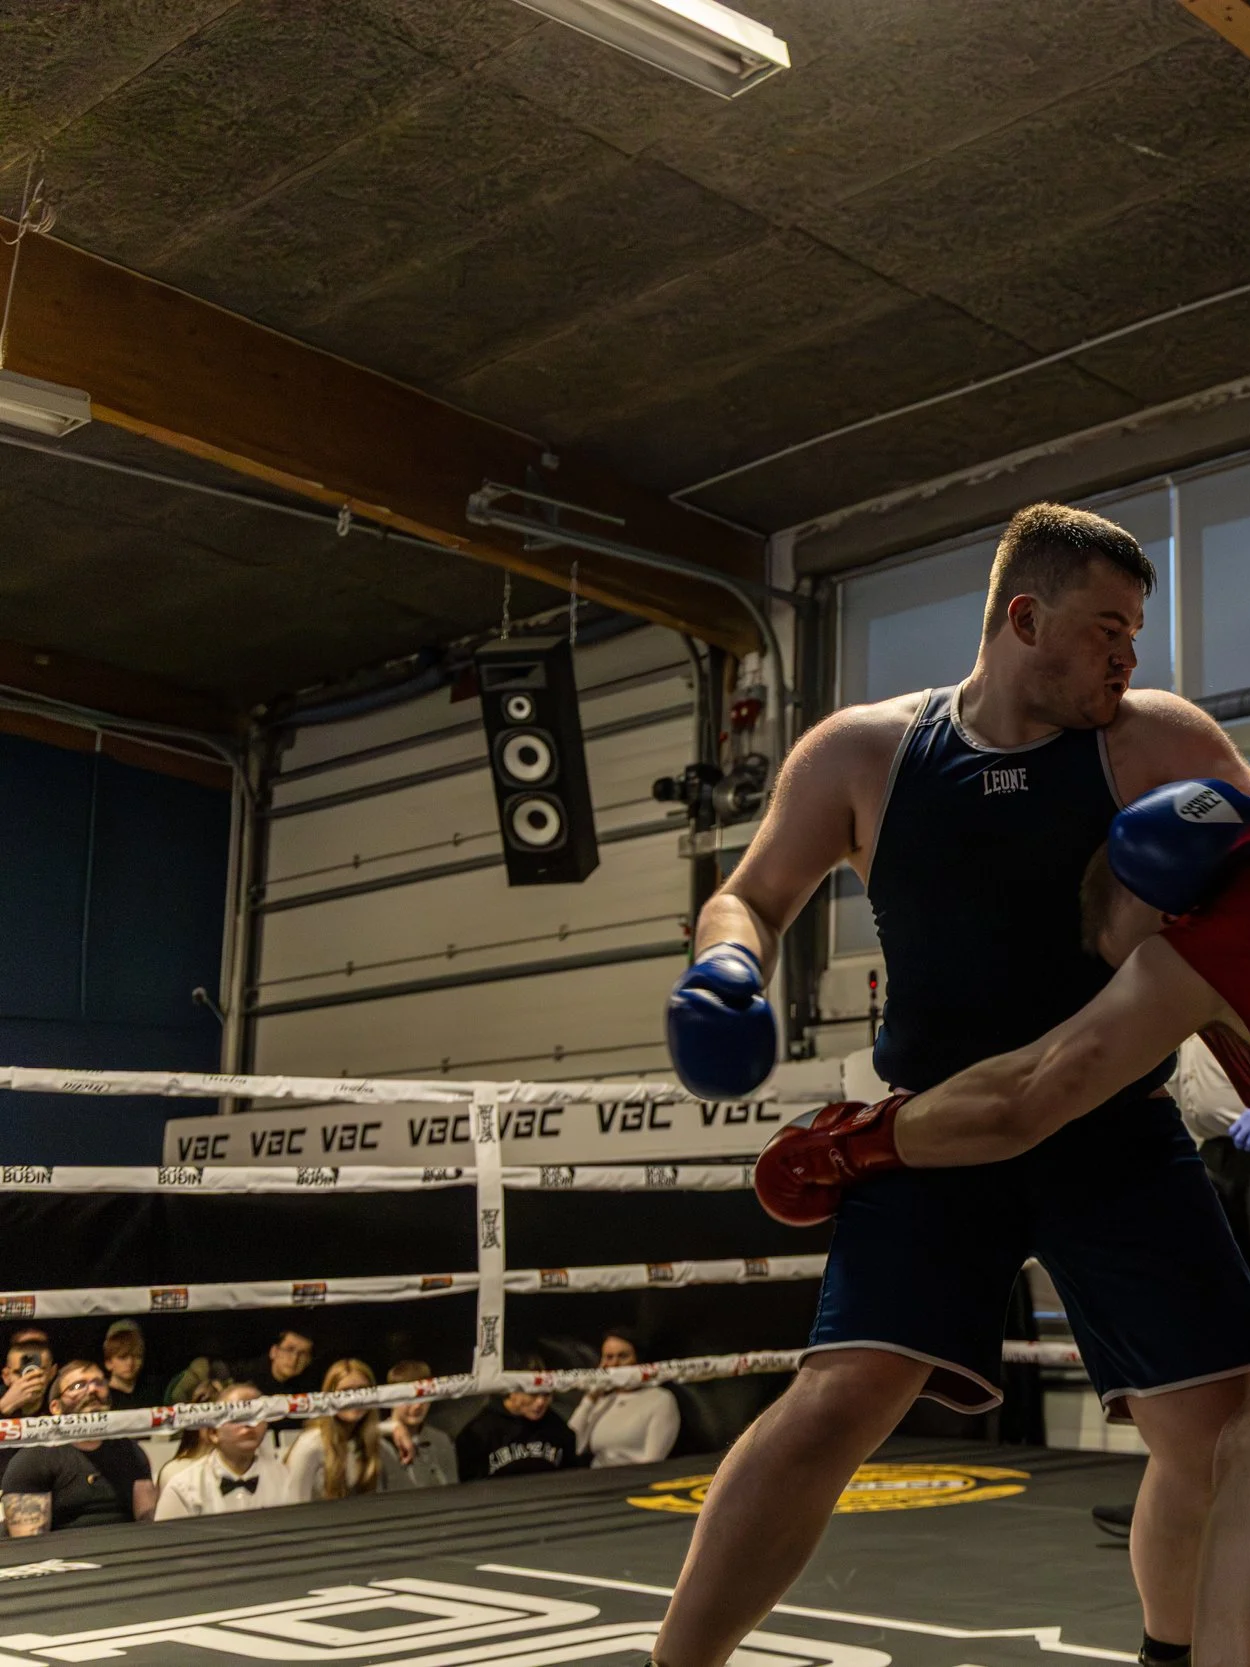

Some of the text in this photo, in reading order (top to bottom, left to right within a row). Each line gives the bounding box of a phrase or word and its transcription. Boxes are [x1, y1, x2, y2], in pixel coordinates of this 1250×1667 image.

[983, 768, 1029, 795] LEONE
[408, 1115, 470, 1146] VBC
[597, 1100, 674, 1133] VBC
[178, 1134, 230, 1161] VBC
[251, 1128, 307, 1157] VBC
[321, 1121, 382, 1152] VBC
